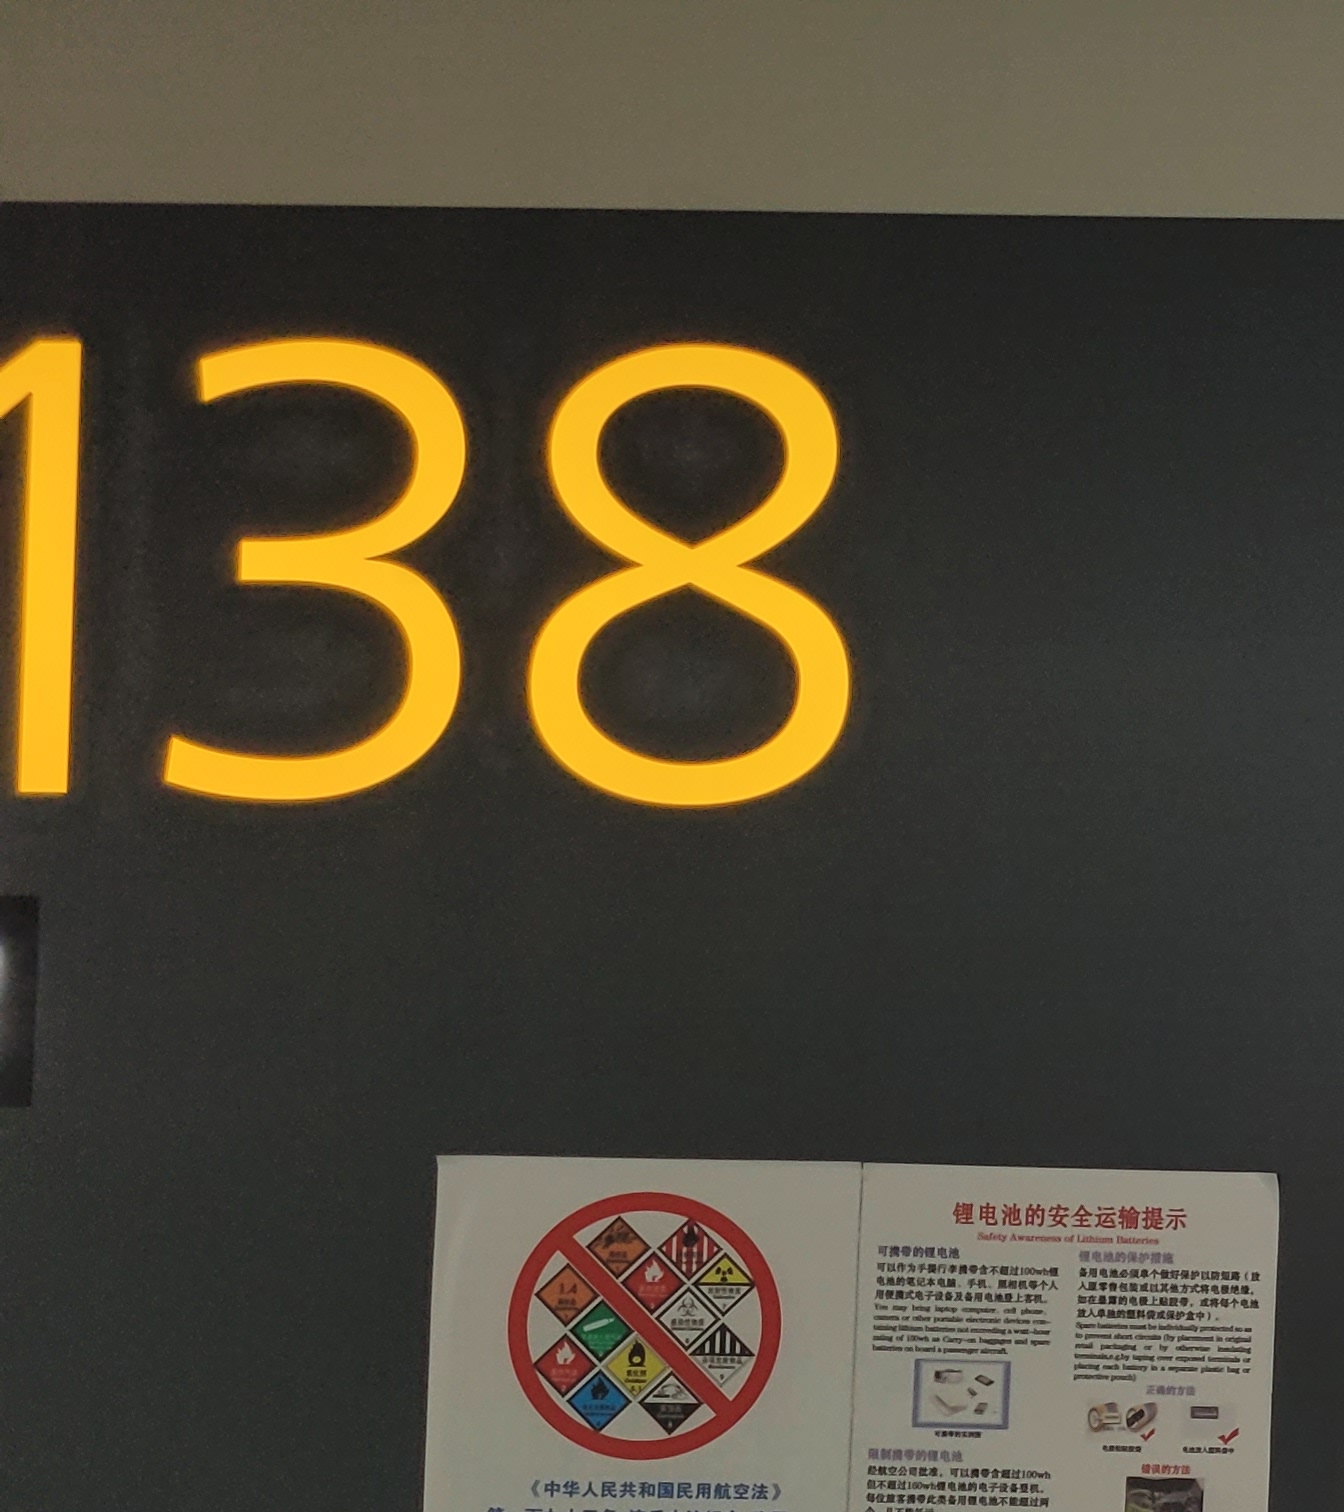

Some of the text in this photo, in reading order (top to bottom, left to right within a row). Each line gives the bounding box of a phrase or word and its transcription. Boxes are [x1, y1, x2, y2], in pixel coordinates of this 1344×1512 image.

[0, 336, 851, 806] 138
[952, 1202, 1188, 1230] 锂电池的安全运输提示
[878, 1245, 960, 1259] 可携带的锂电池
[530, 1481, 782, 1500] 《中华人民共和国民用航空法》
